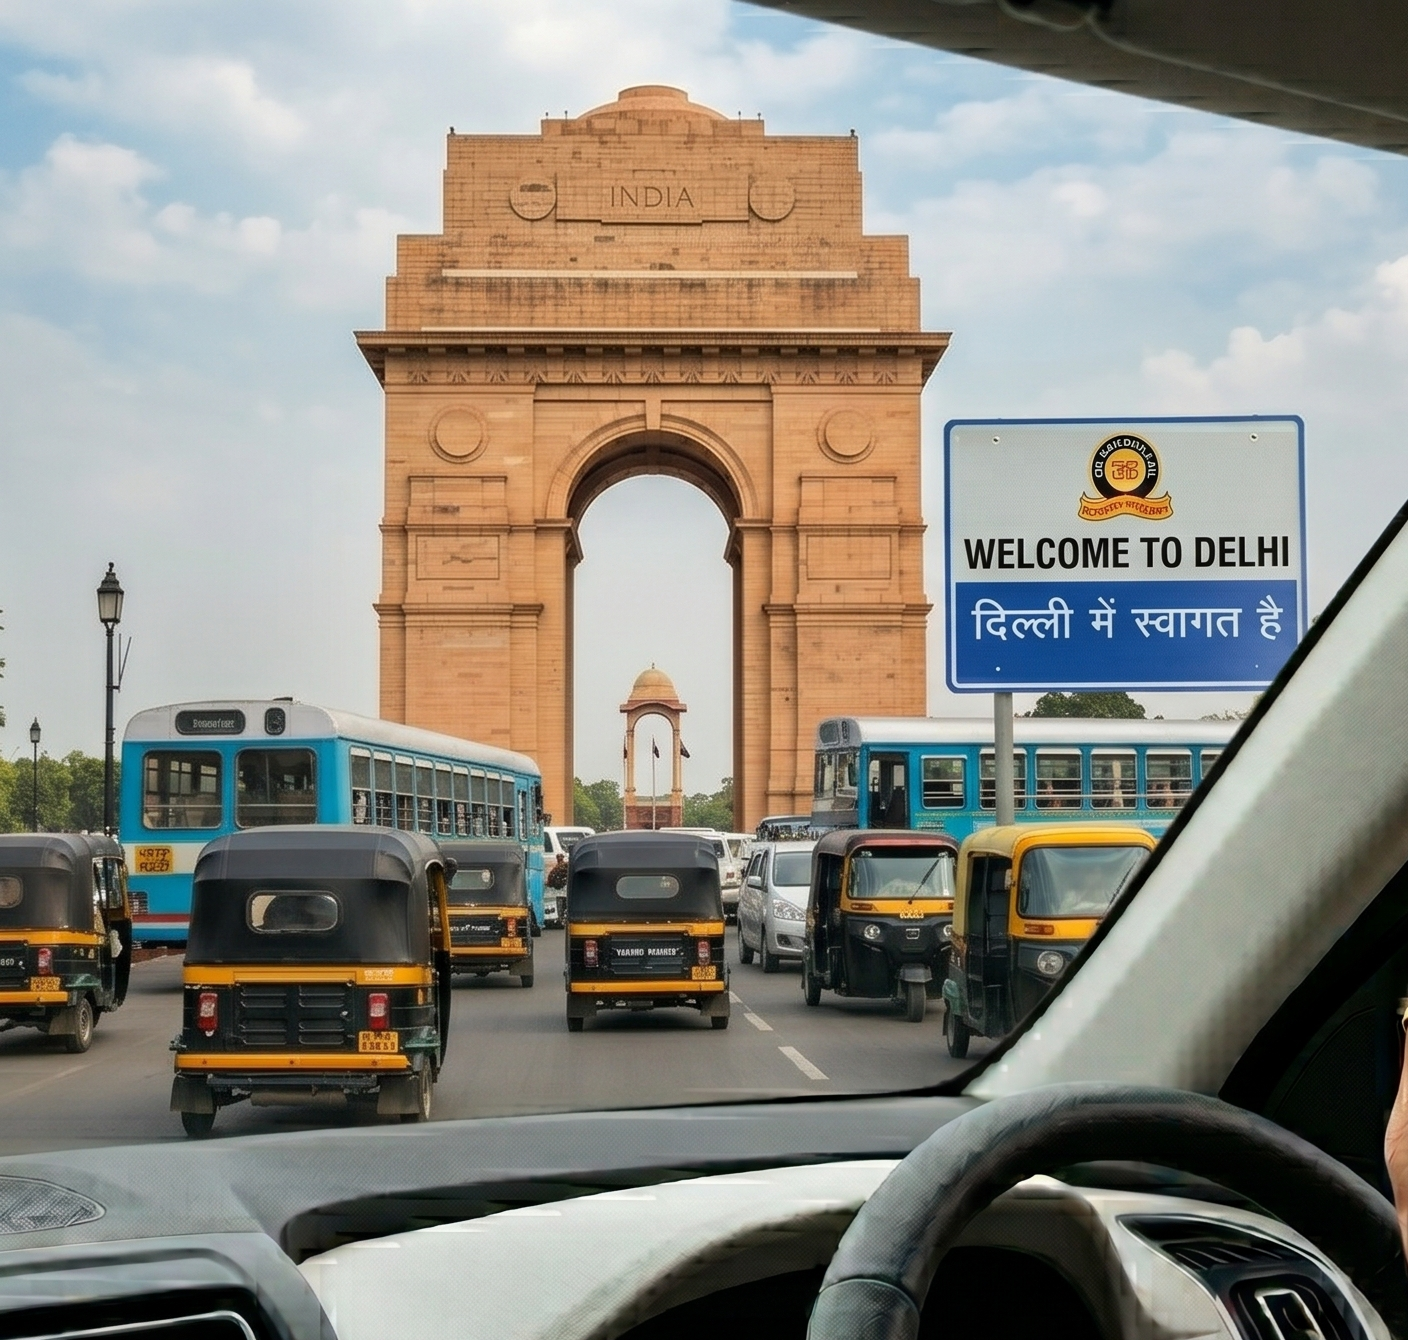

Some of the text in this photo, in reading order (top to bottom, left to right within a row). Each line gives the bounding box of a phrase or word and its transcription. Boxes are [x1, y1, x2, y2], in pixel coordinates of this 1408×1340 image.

[611, 186, 694, 208] INDIA
[964, 536, 1290, 569] WELCOME TO DELHI
[971, 595, 1283, 641] दिल्ली में स्वागत है
